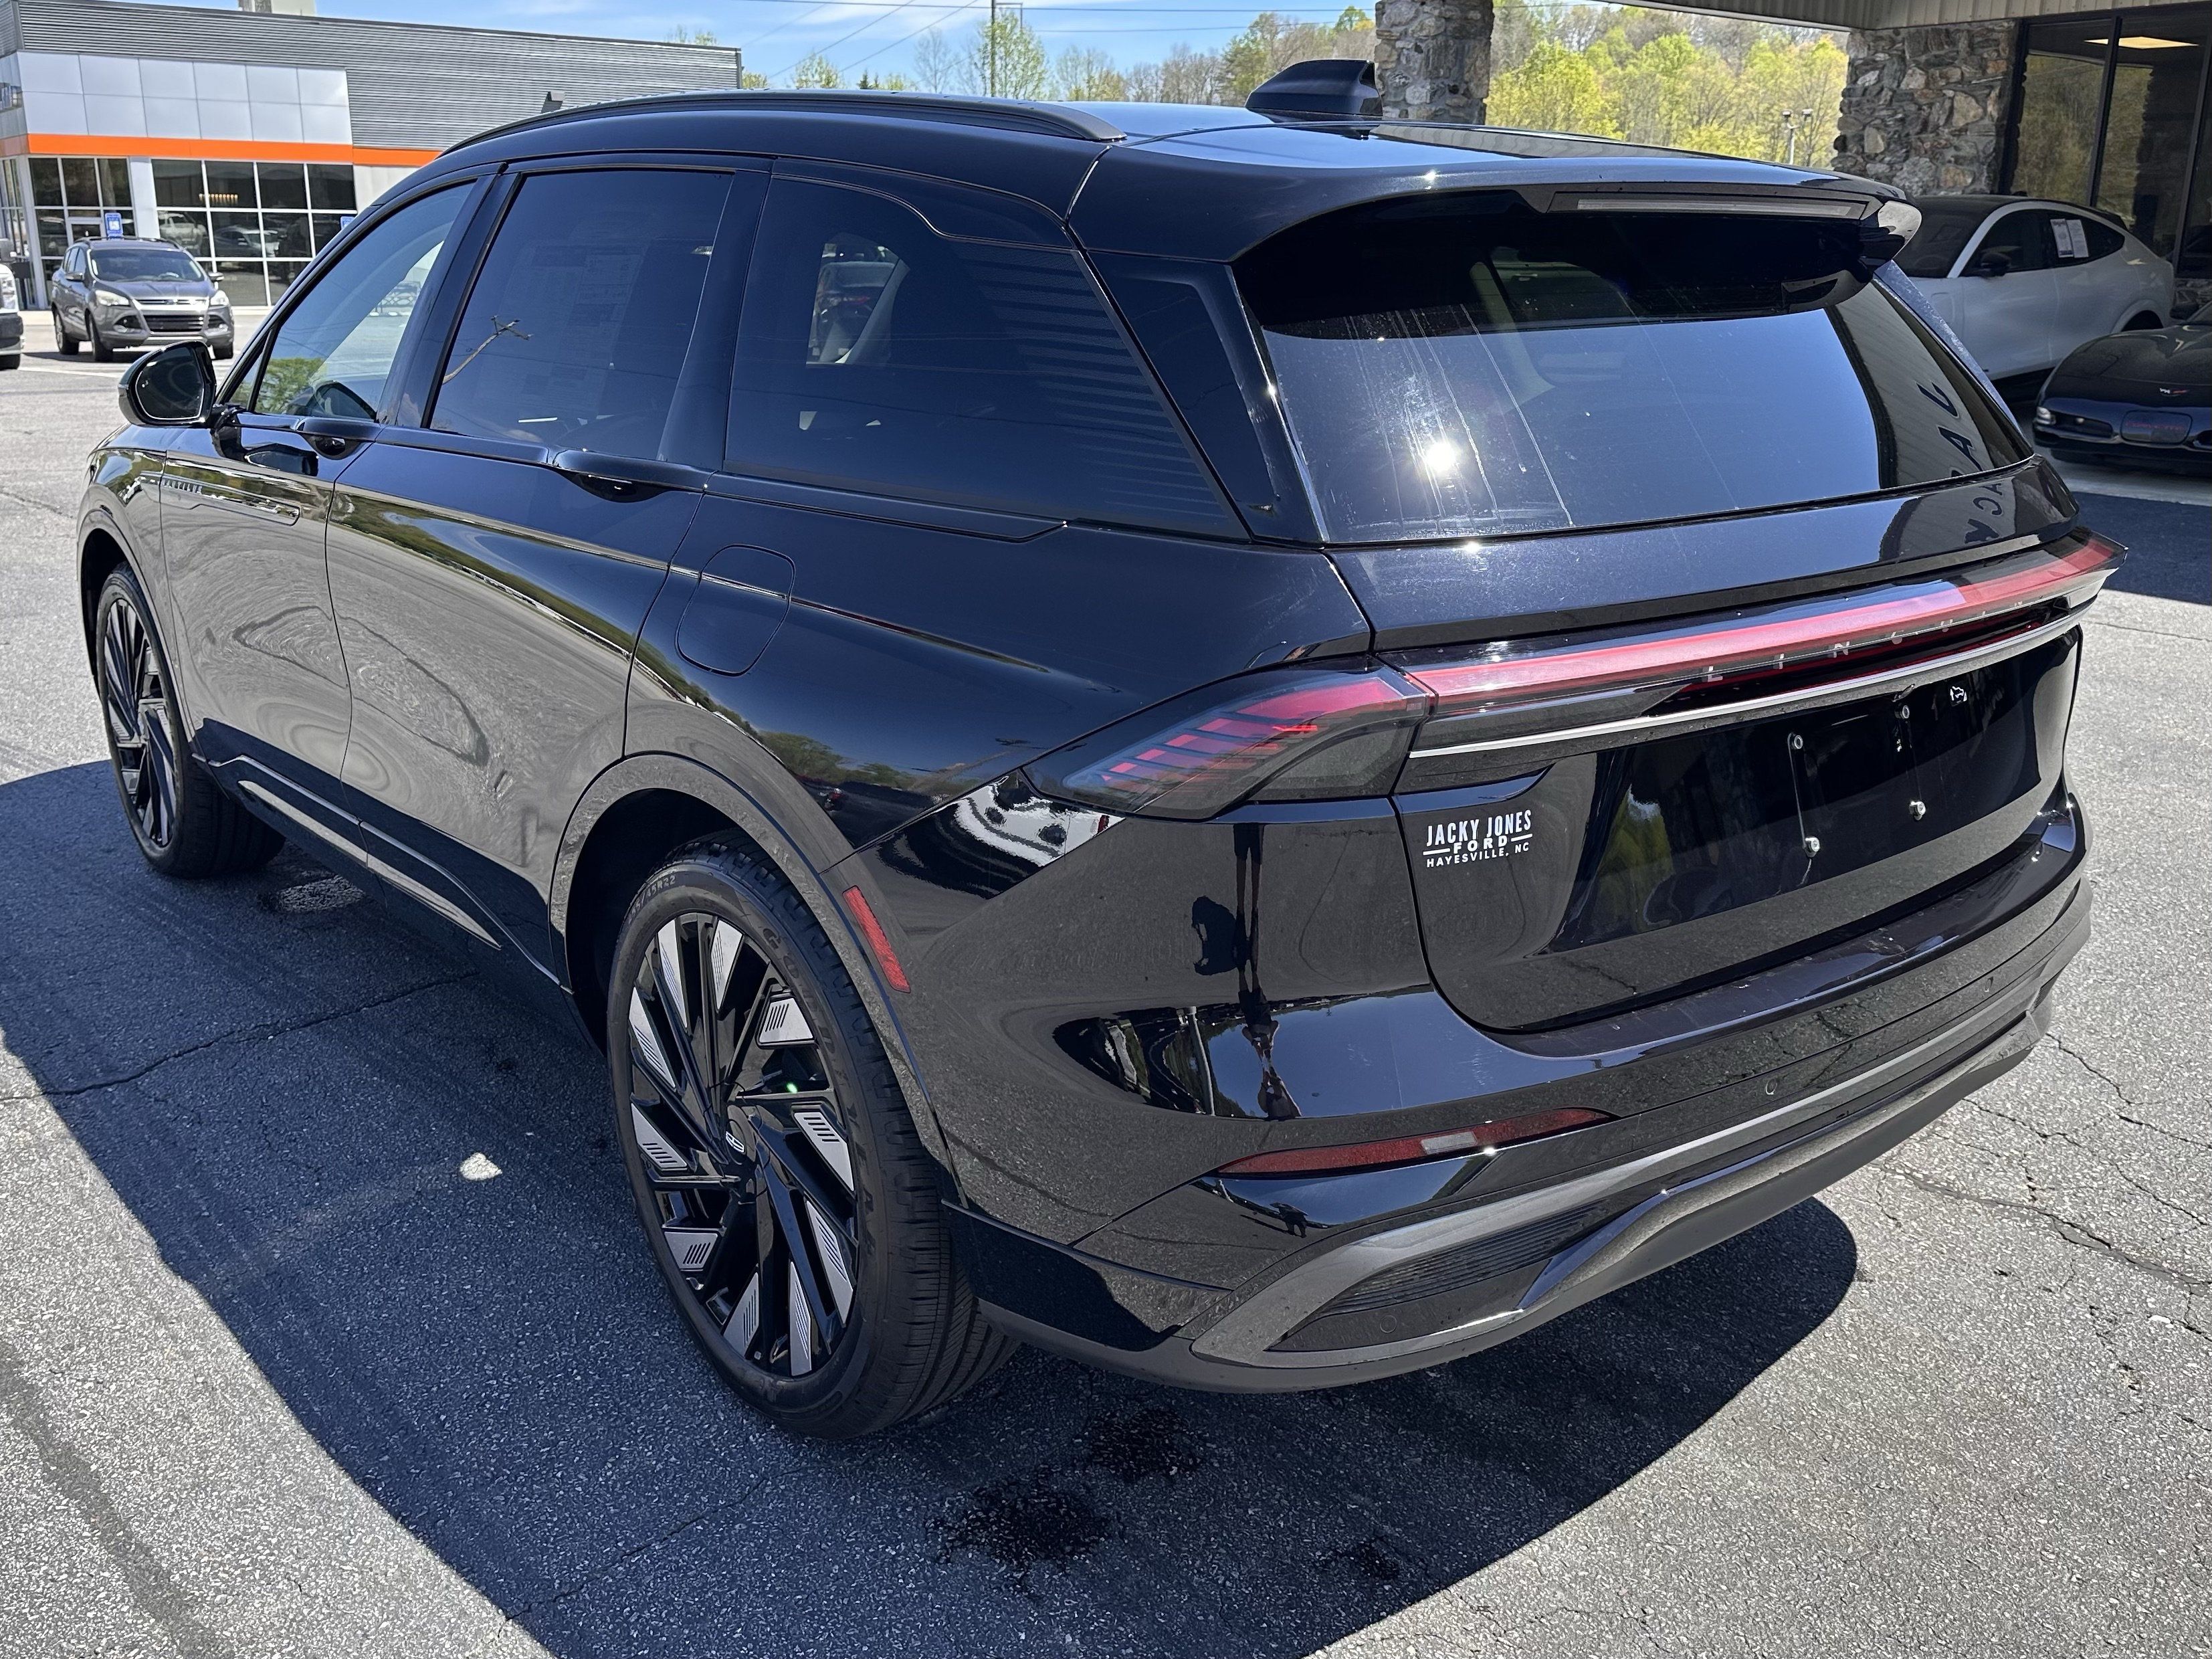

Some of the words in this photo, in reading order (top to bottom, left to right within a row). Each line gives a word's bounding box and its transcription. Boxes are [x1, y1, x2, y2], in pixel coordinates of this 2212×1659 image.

[1427, 819, 1480, 847] JACKY
[1486, 809, 1532, 838] JONES
[1427, 846, 1510, 868] HAYESVILLE,
[1514, 841, 1530, 854] NC
[1453, 836, 1508, 854] FORD
